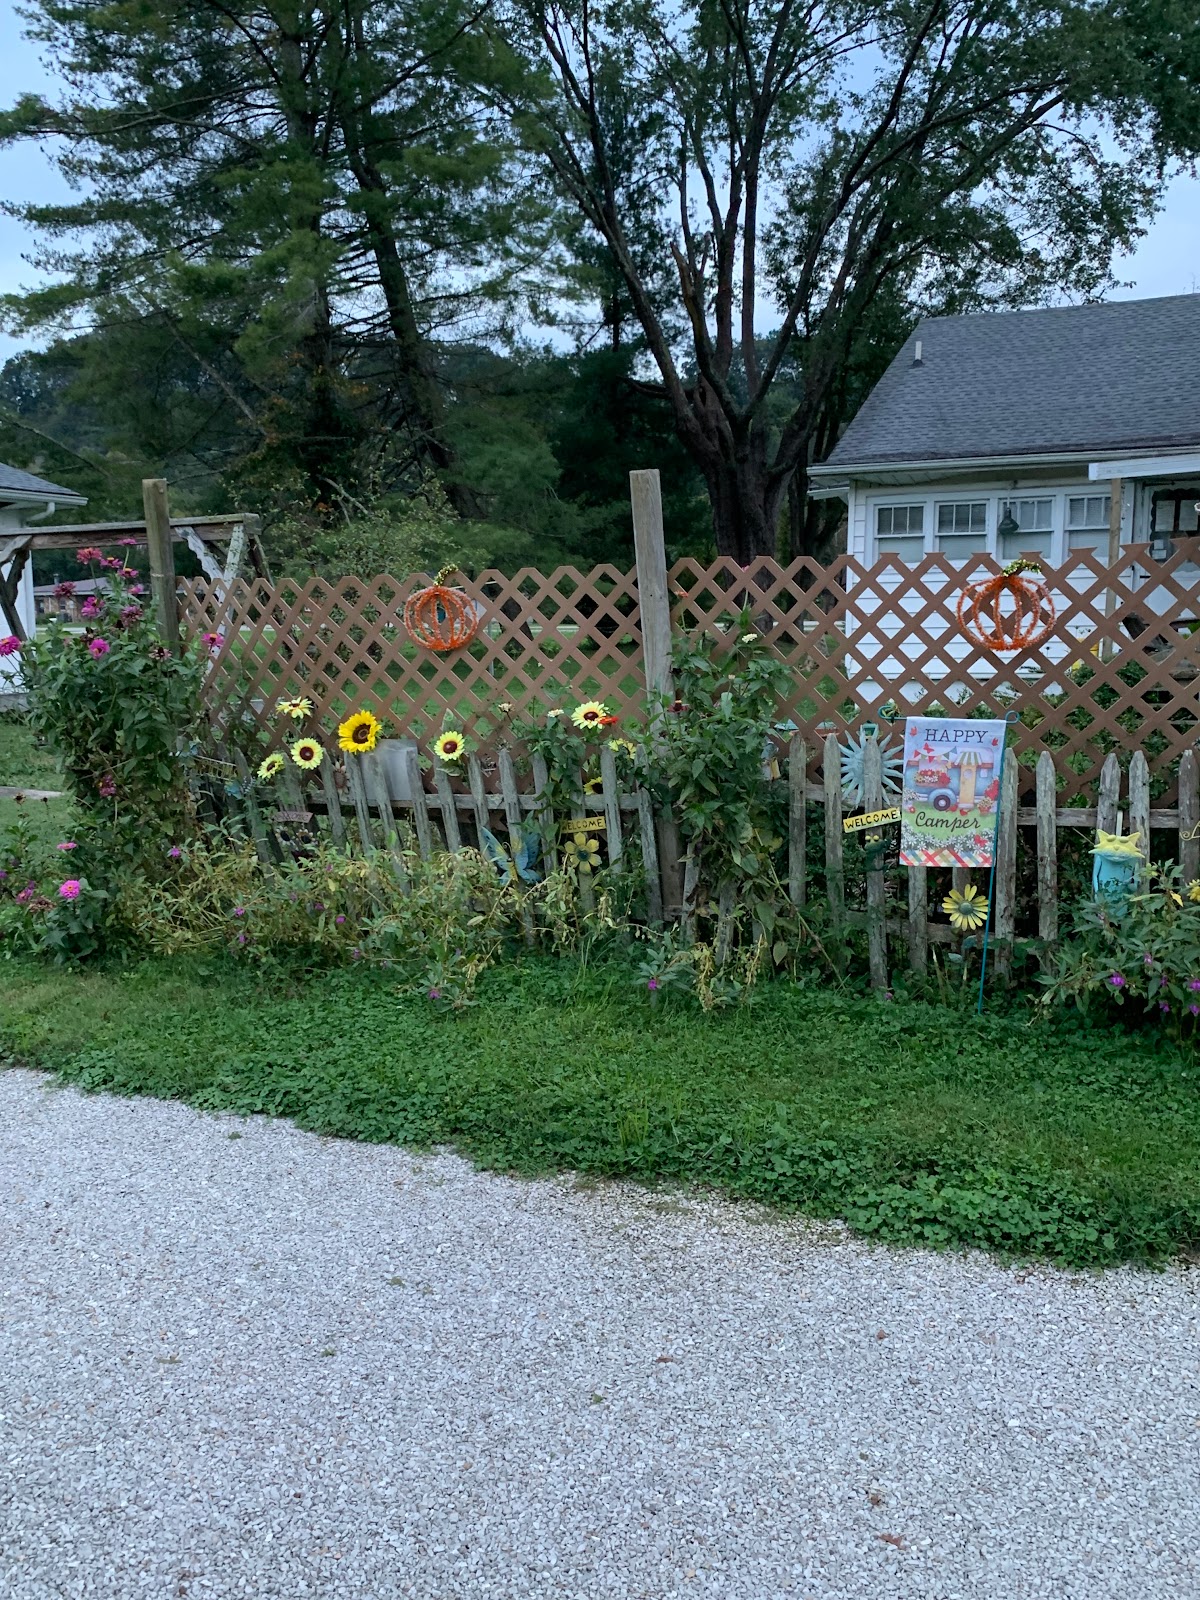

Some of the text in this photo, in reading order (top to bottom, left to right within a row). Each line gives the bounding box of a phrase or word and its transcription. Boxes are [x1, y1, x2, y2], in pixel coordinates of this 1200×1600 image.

[924, 728, 988, 743] HAPPY
[845, 809, 899, 829] WELCOME
[915, 811, 981, 833] Camper
